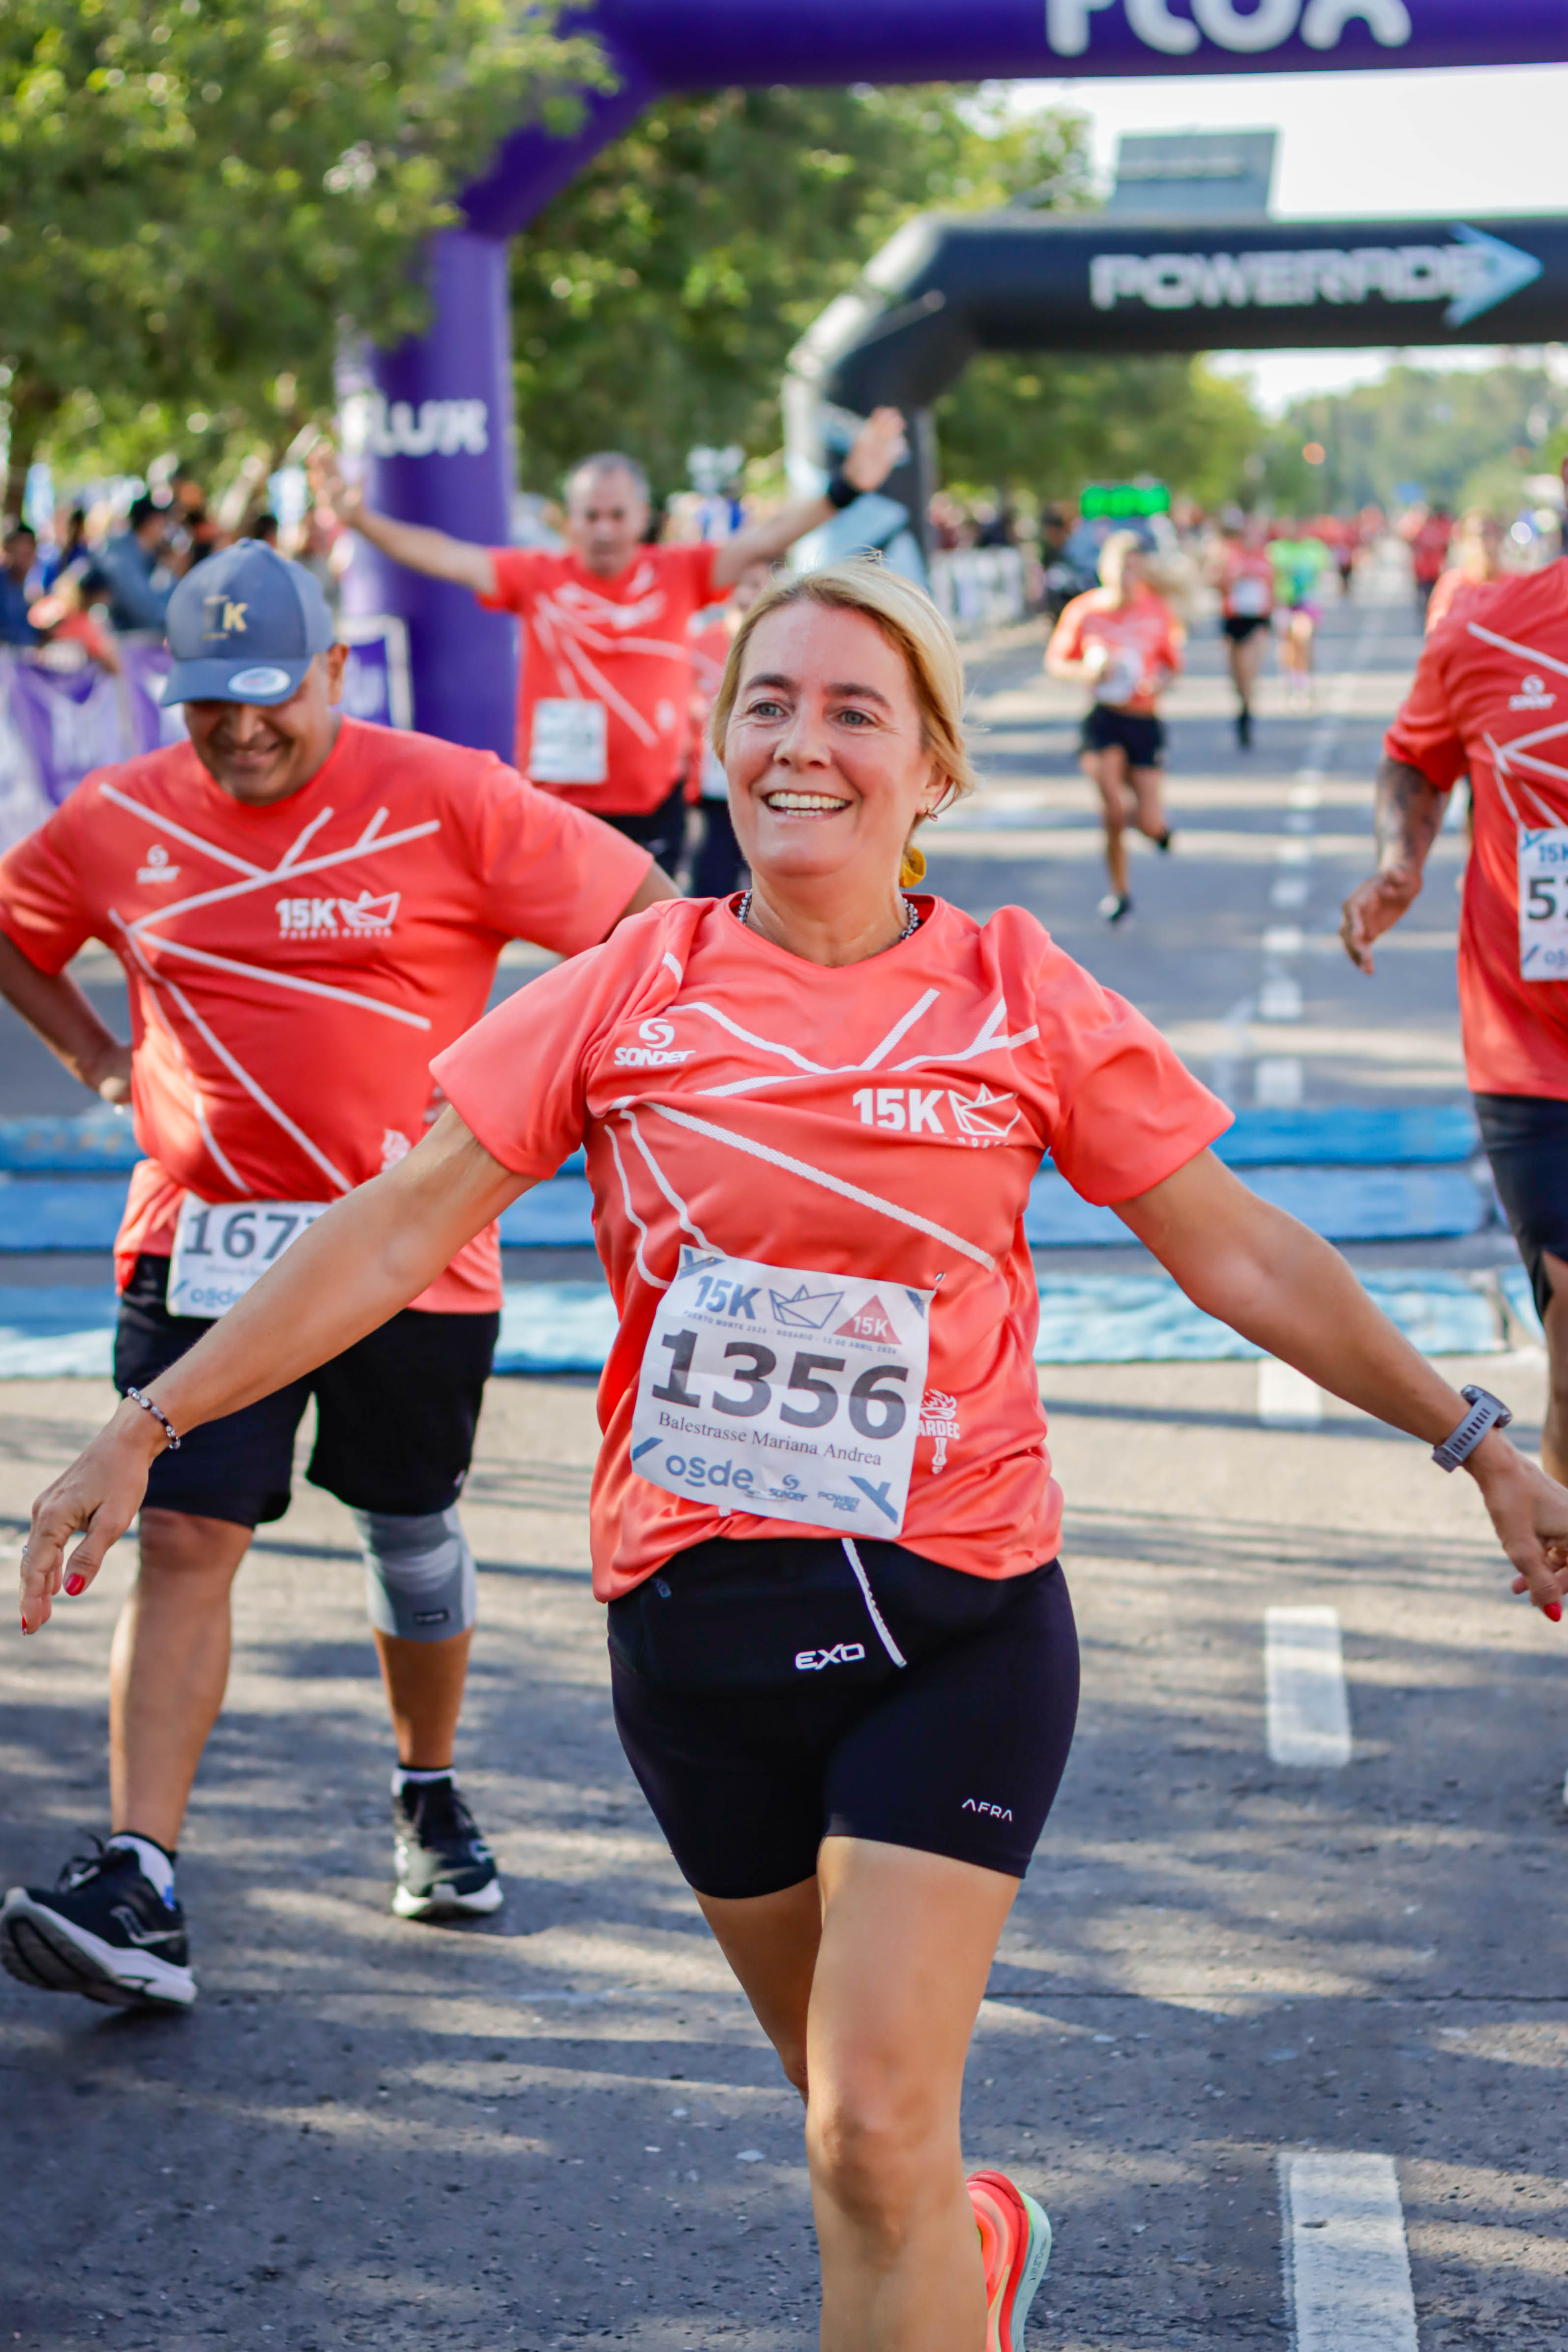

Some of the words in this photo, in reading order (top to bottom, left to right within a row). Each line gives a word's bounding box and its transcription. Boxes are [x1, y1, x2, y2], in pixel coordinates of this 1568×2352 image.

[275, 898, 338, 930] 15K
[853, 1088, 945, 1133] 15K
[183, 1210, 315, 1260] 167
[694, 1275, 763, 1320] 15K
[716, 1319, 743, 1330] NORTE
[776, 1329, 813, 1341] ROSARIO
[849, 1342, 873, 1352] ABRIL
[854, 1316, 888, 1338] 15K
[651, 1329, 909, 1440] 1356
[658, 1411, 747, 1442] Balestrasse
[752, 1430, 818, 1455] Mariana
[823, 1443, 882, 1466] Andrea
[665, 1454, 754, 1490] osde
[795, 1644, 865, 1669] EXO
